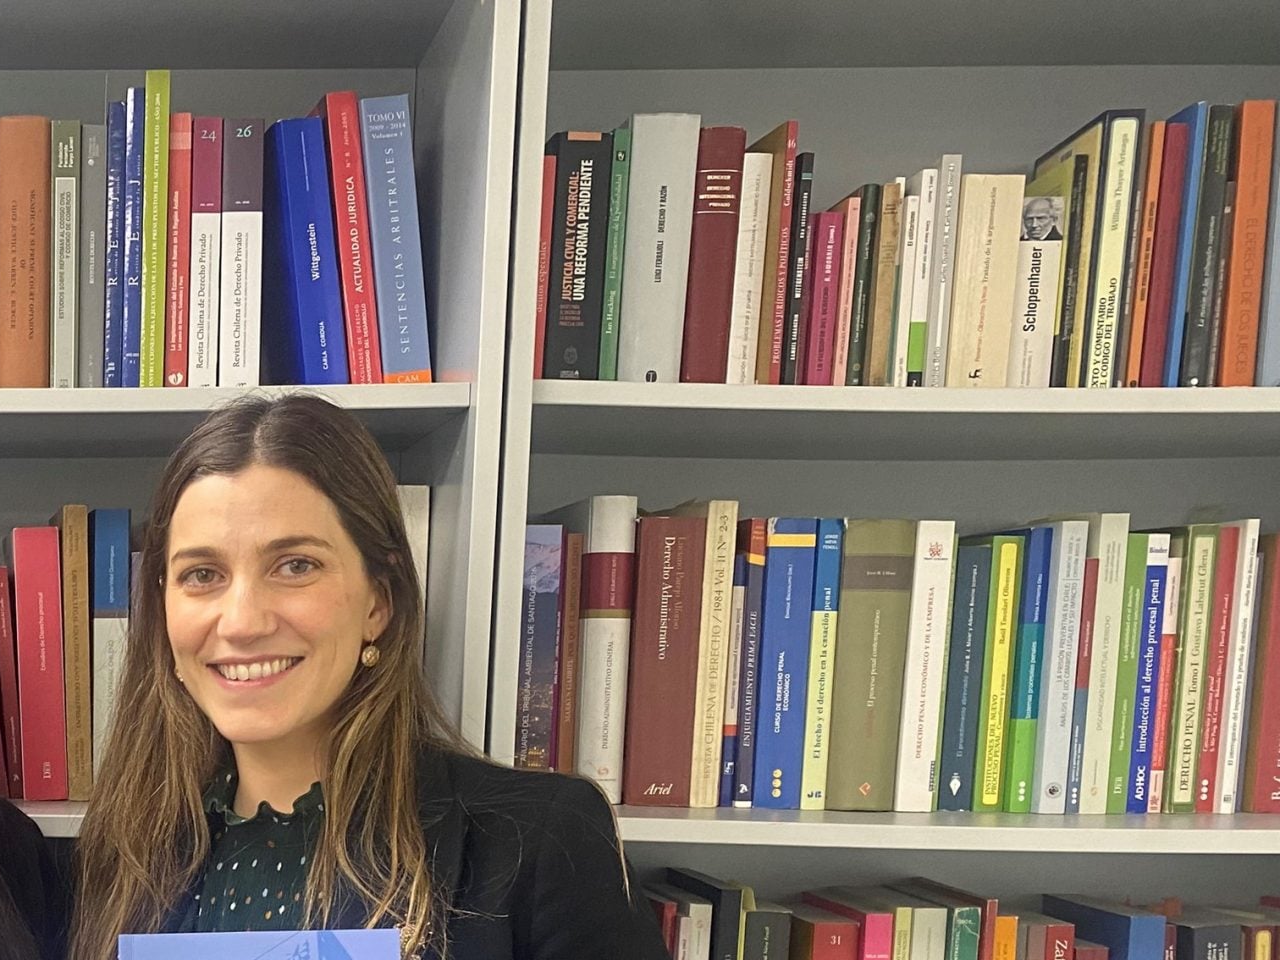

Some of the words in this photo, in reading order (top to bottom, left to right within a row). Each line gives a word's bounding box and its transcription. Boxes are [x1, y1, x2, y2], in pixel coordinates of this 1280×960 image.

[201, 130, 216, 142] 24
[236, 125, 252, 137] 26
[345, 176, 357, 224] JURIDICA
[384, 147, 400, 244] ARBITRALES
[566, 171, 580, 226] COMERCIAL:
[577, 159, 592, 219] PENDIENTE
[198, 233, 206, 262] Privado
[305, 222, 322, 280] Wittgenstein
[350, 228, 363, 293] ACTUALIDAD
[564, 235, 575, 259] CIVIL
[574, 221, 588, 274] REFORMA
[197, 264, 205, 296] Derecho
[561, 260, 574, 300] JUSTICIA
[572, 276, 585, 300] UNA
[1022, 246, 1045, 332] Schopenhauer
[197, 298, 204, 308] de
[393, 253, 409, 353] SENTENCIAS
[196, 309, 204, 340] Chilena
[662, 536, 675, 580] Derecho
[1148, 578, 1161, 604] penal
[657, 582, 672, 659] Administrativo
[1145, 606, 1159, 644] procesal
[1142, 645, 1154, 683] derecho
[1140, 684, 1151, 693] al
[1136, 695, 1150, 752] introducción
[643, 782, 673, 795] Ariel
[830, 935, 841, 944] 31
